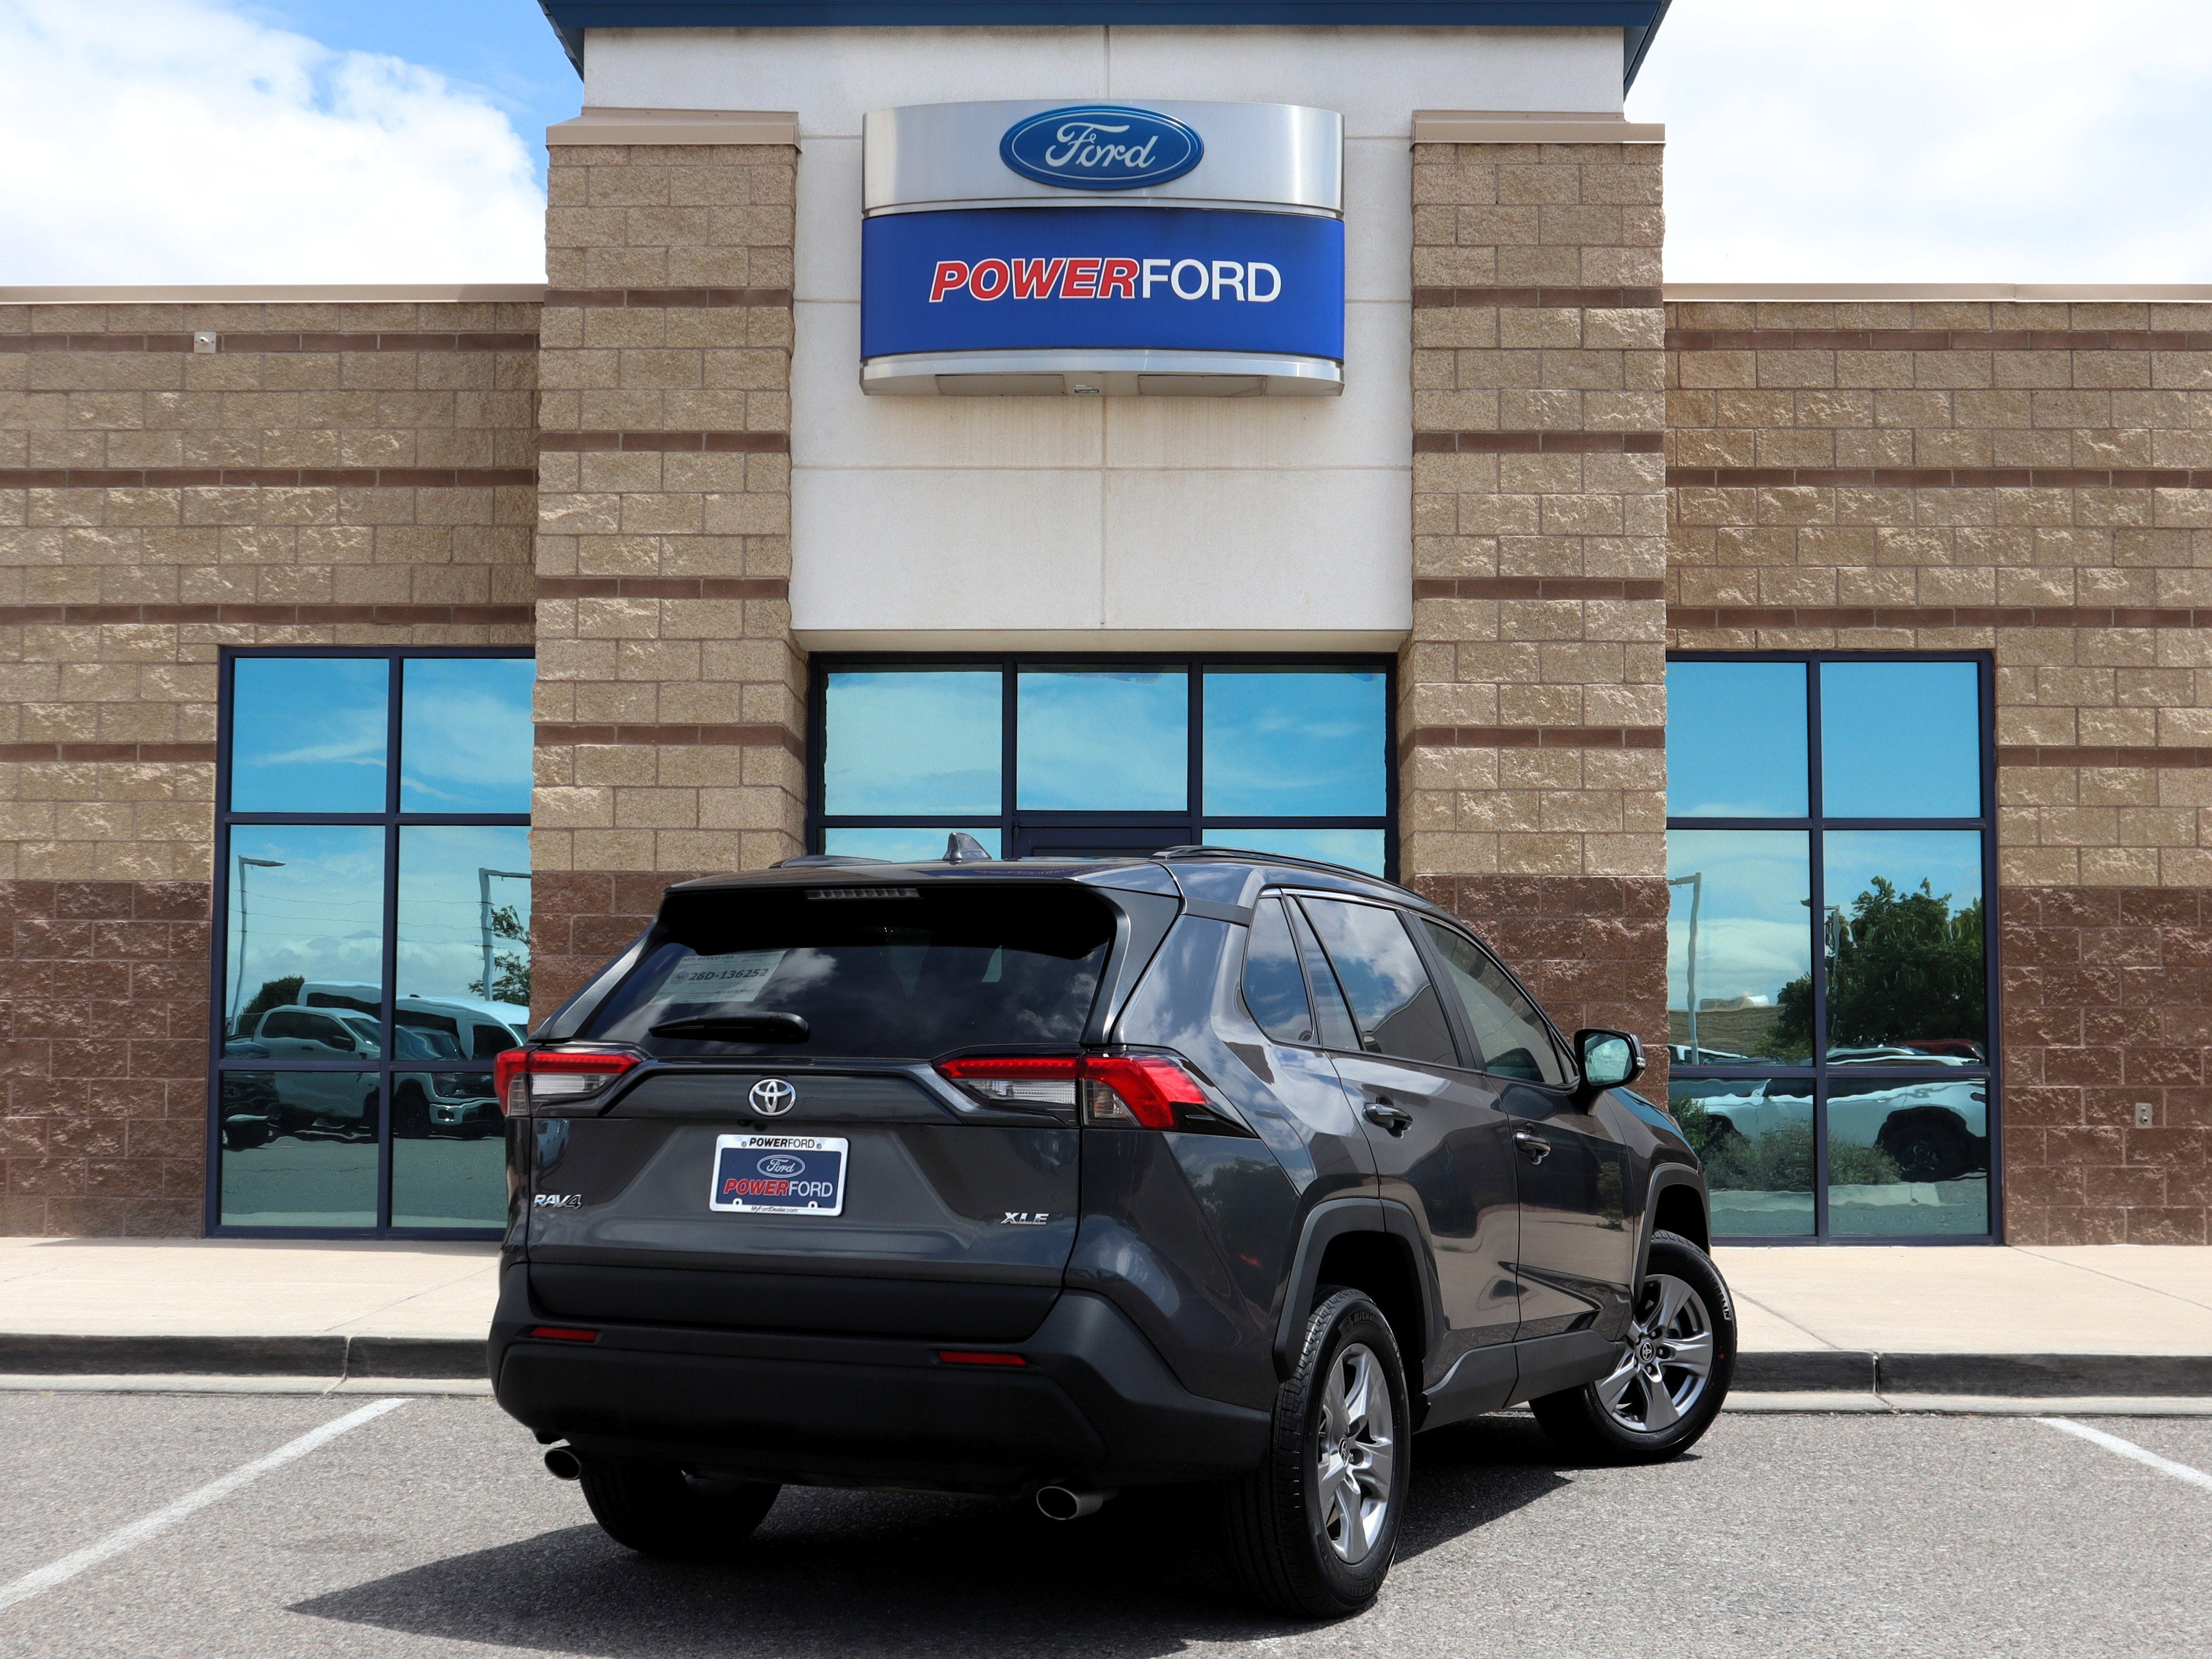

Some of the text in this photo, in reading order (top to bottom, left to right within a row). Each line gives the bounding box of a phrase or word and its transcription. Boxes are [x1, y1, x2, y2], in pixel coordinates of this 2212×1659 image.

[1045, 121, 1159, 169] Ford
[688, 968, 769, 981] 26D-136252
[766, 1158, 796, 1173] Ford
[533, 1194, 582, 1209] RAV4
[1000, 1212, 1049, 1225] XLE
[1703, 1269, 1731, 1319] MICHELIN
